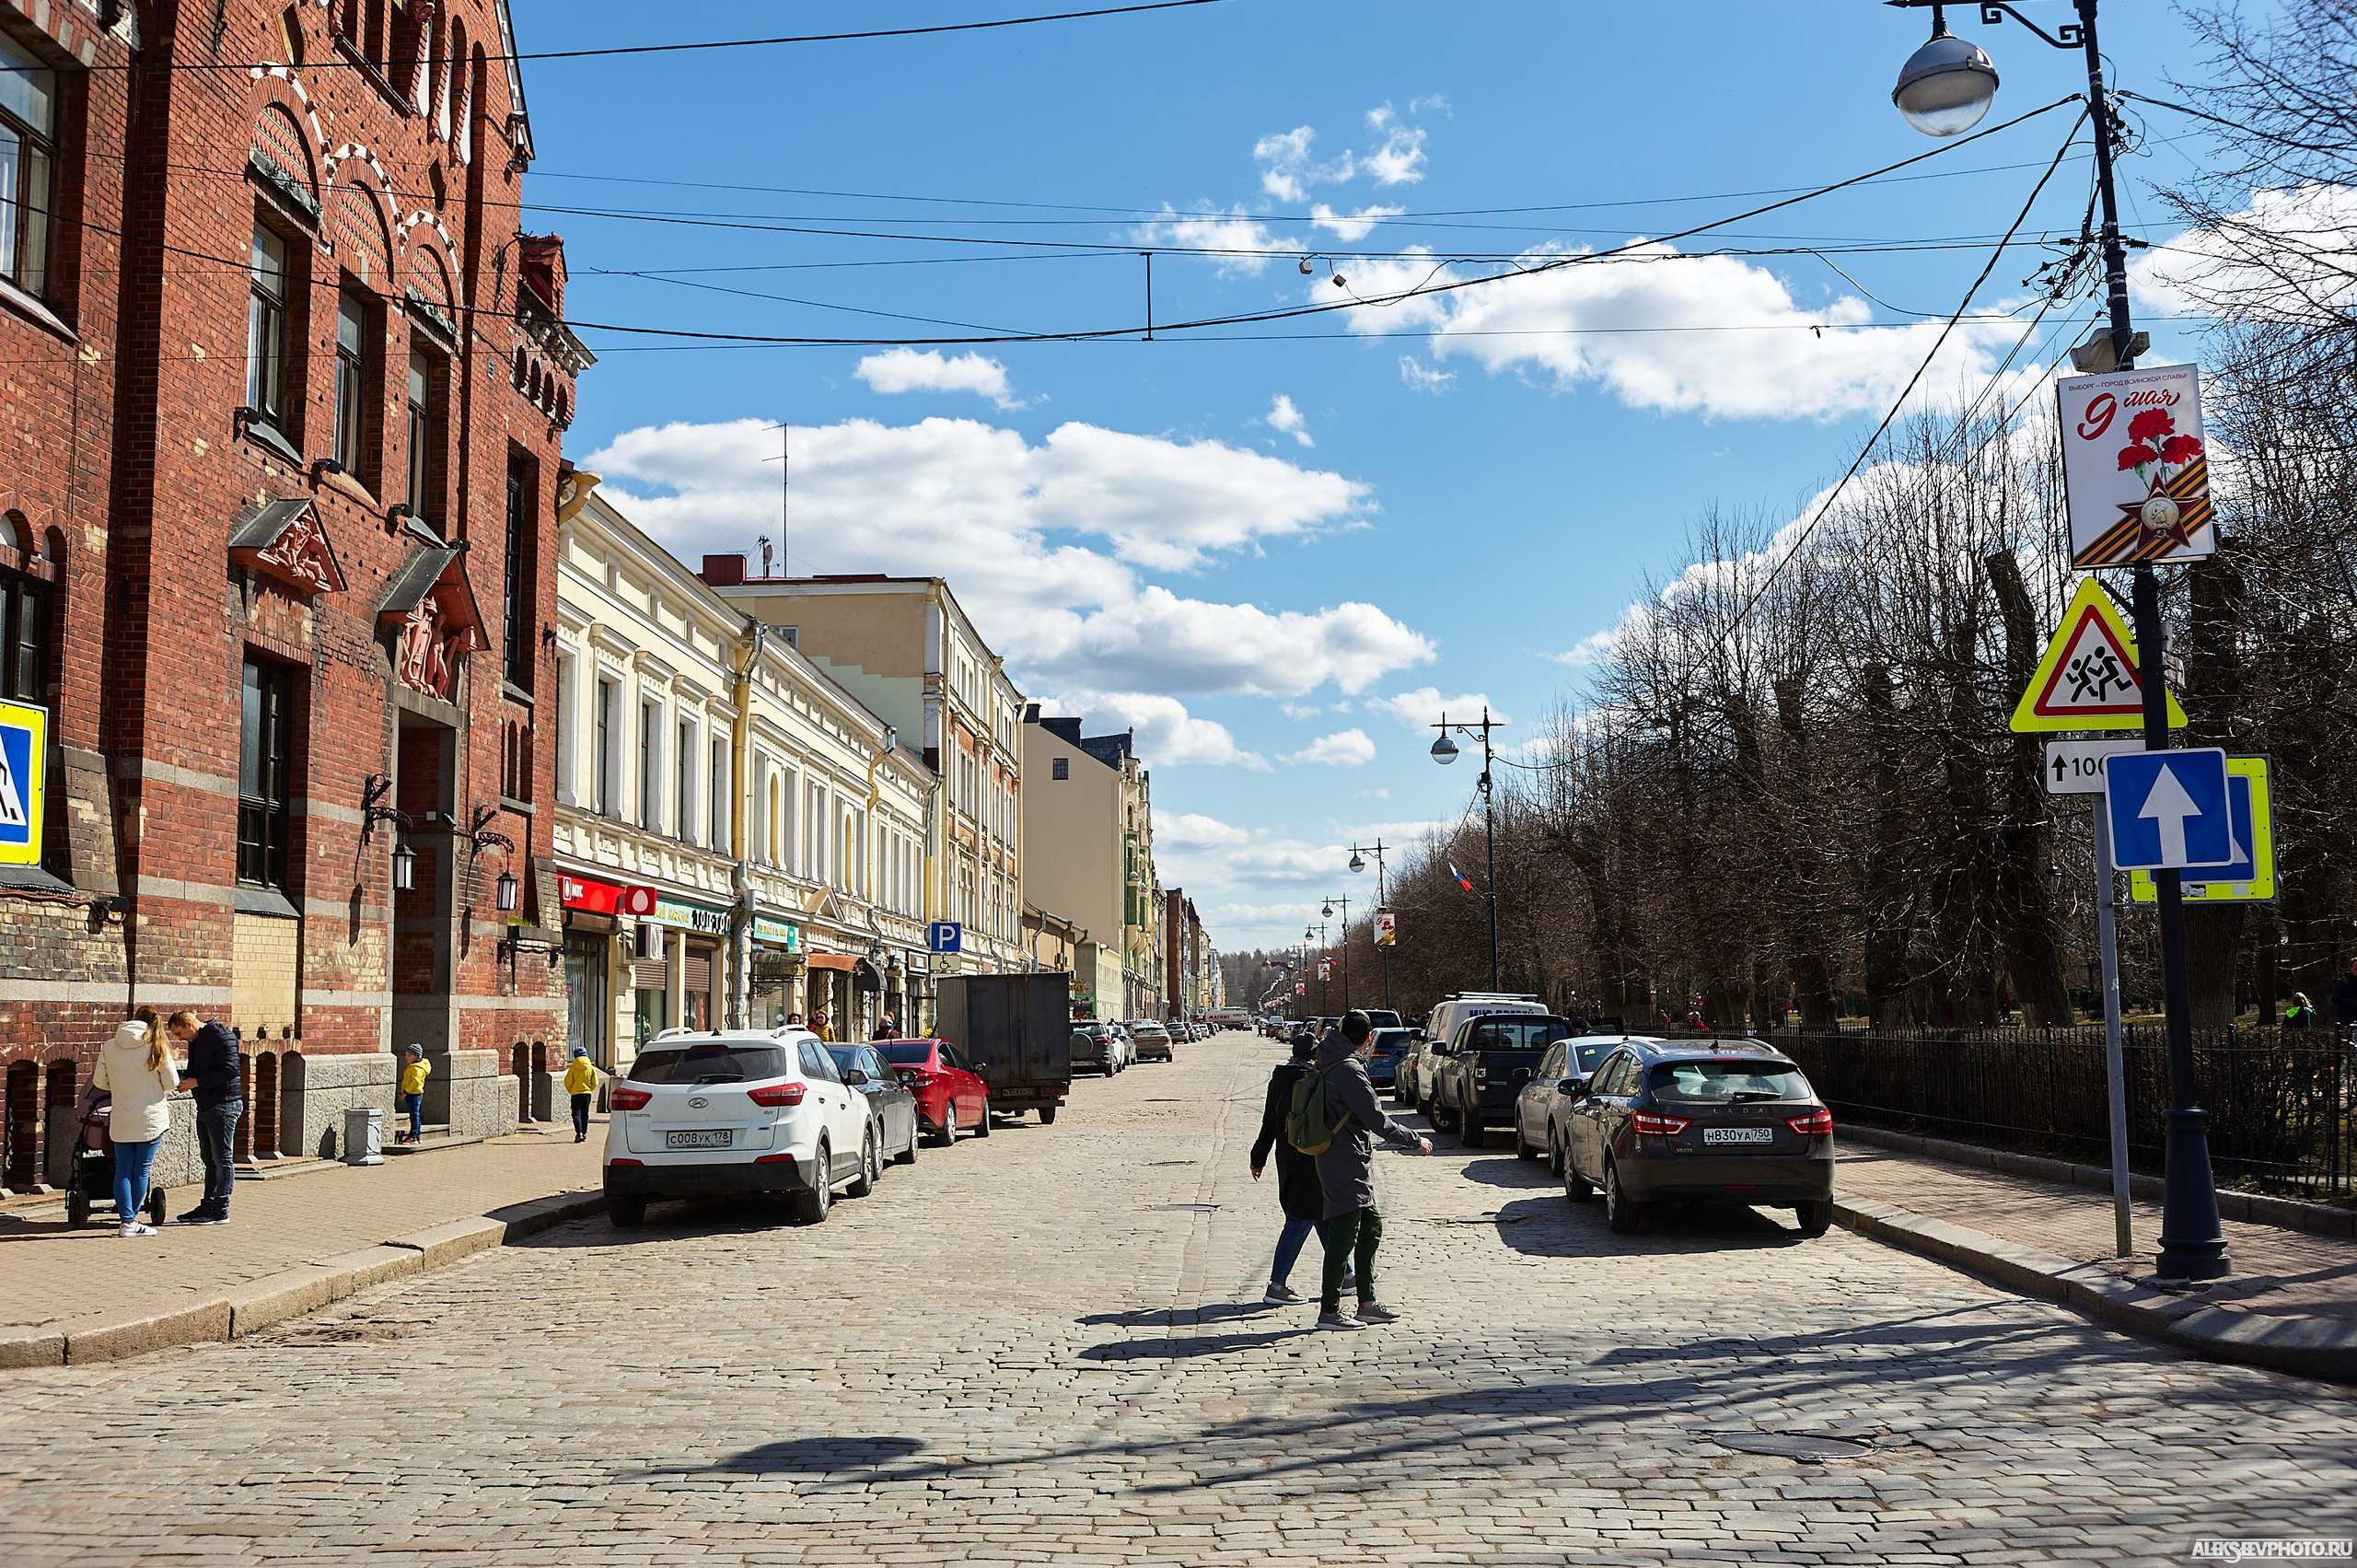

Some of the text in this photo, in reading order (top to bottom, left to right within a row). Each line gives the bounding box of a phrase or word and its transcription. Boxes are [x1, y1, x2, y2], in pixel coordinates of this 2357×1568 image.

[2068, 383, 2095, 391] ВЫБОРГ
[2101, 379, 2124, 388] ГОРОД
[2124, 376, 2162, 386] ВОИНСКОЙ
[2162, 373, 2188, 381] СЛАВЫ!
[2077, 389, 2181, 441] 9 мая
[938, 925, 956, 949] P
[1753, 1129, 1770, 1138] 750
